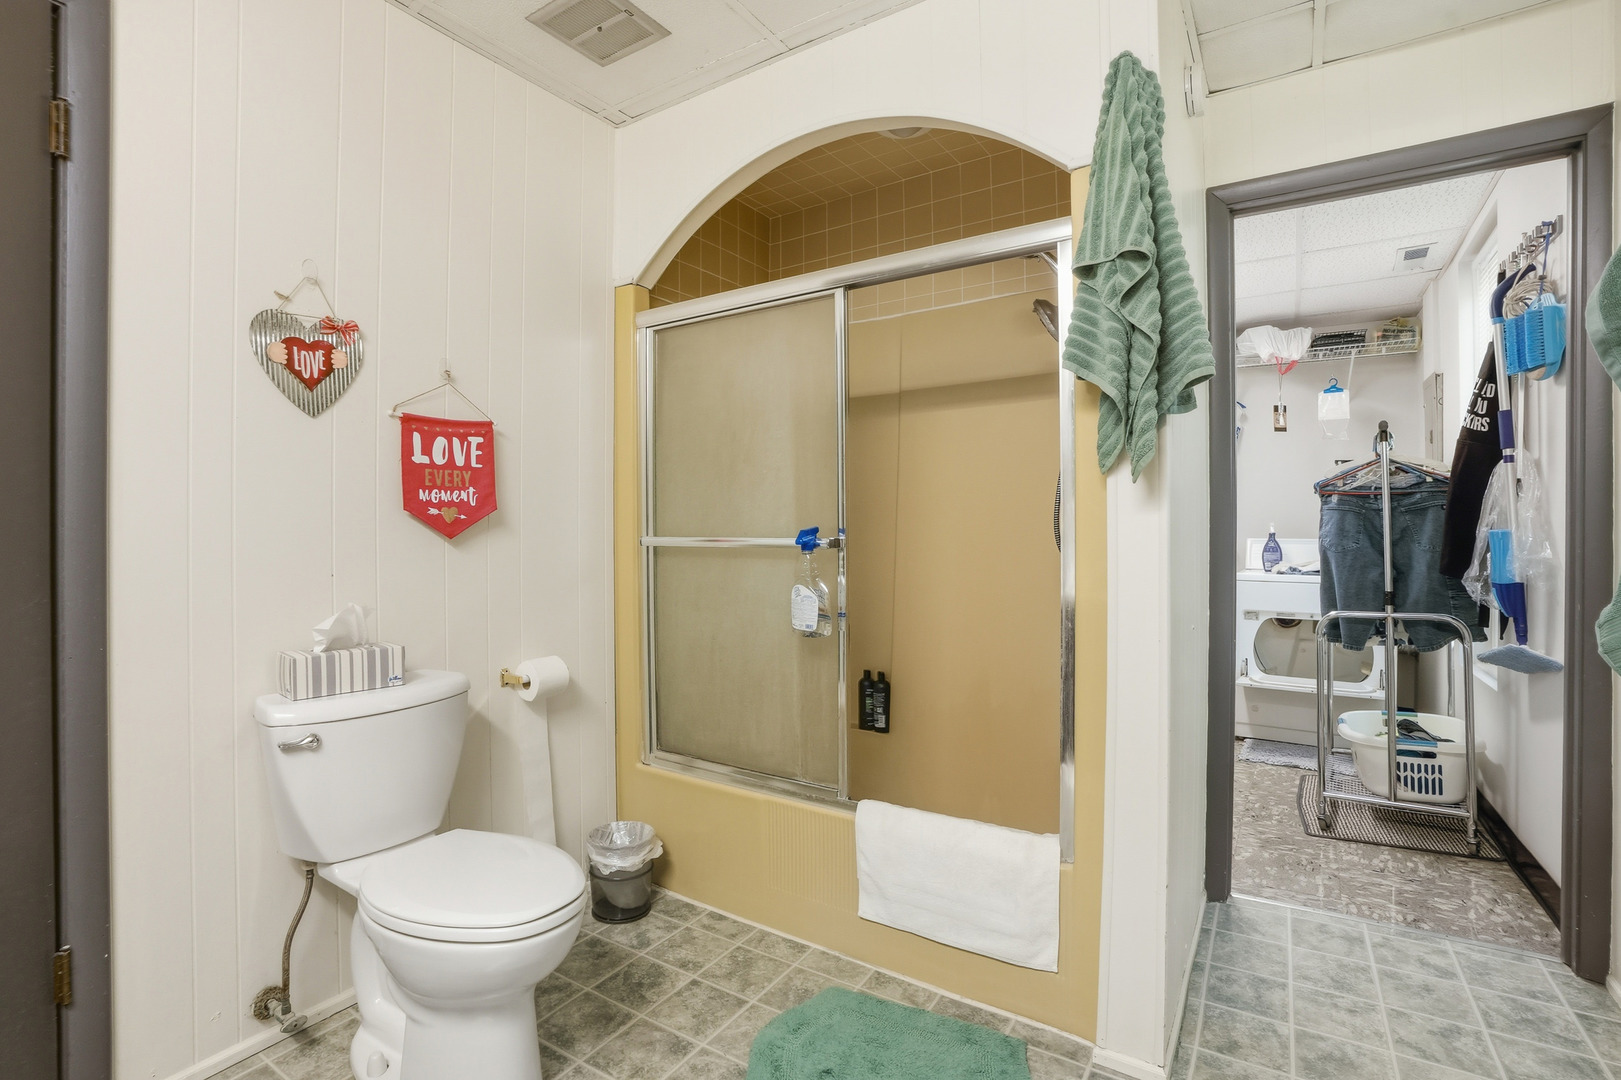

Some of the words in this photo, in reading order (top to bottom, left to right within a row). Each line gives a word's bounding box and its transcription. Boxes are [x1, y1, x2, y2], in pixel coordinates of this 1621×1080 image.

[293, 346, 326, 379] LOVE
[411, 431, 484, 468] LOVE
[424, 468, 472, 487] EVERY
